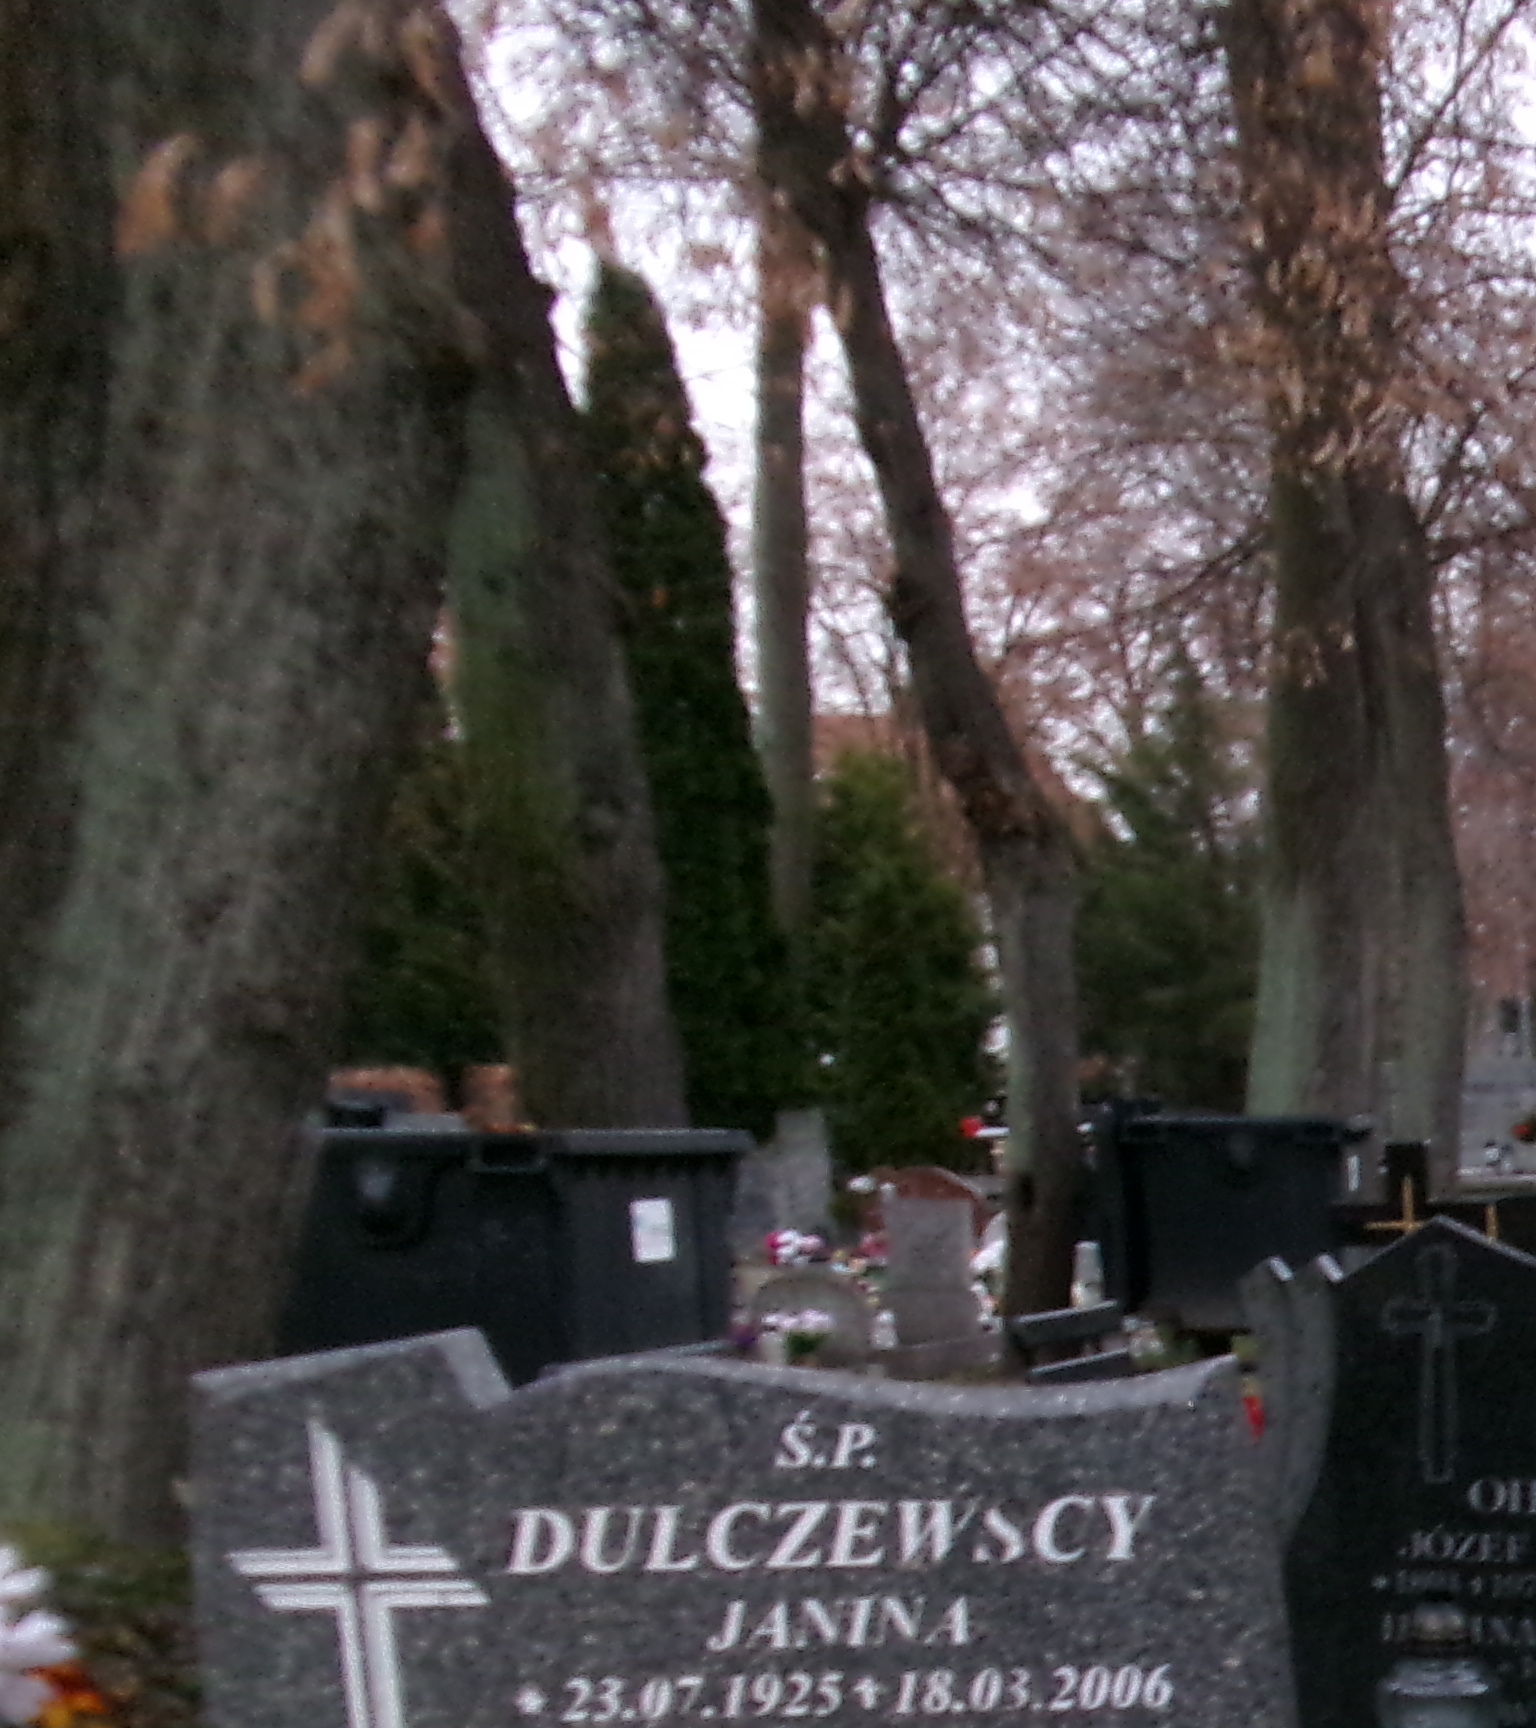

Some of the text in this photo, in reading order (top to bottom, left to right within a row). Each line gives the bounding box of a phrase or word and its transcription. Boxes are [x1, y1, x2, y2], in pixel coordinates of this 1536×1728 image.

[775, 1410, 878, 1470] Ś.P.
[507, 1494, 1157, 1575] DULCZEWSCY
[706, 1595, 971, 1652] JANINA
[560, 1663, 1174, 1724] 23.07.1925 18.03.2006
